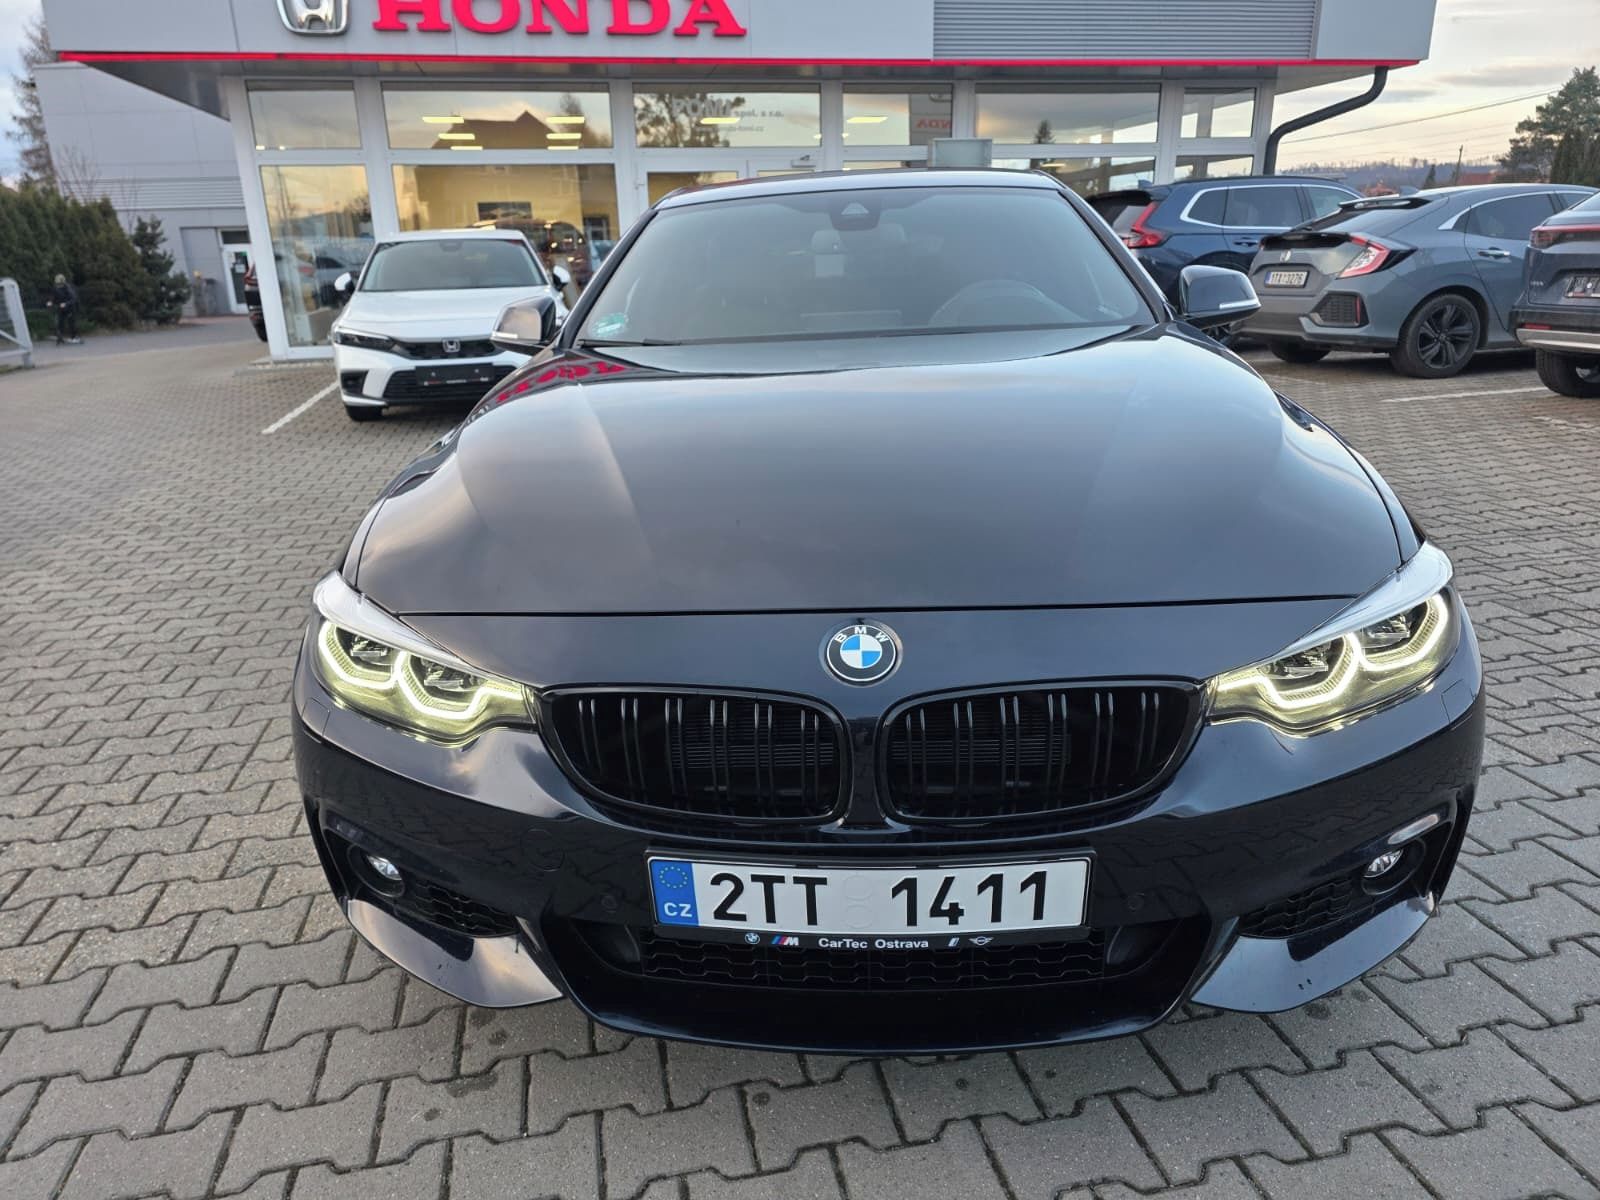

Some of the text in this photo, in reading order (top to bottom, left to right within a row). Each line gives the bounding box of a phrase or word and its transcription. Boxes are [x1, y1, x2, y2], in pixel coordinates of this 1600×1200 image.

[372, 0, 747, 37] HONDA
[834, 625, 890, 643] BMW
[709, 870, 1048, 927] 2TT 1411
[663, 902, 693, 918] CZ
[818, 938, 929, 949] CarTec Ostrava
